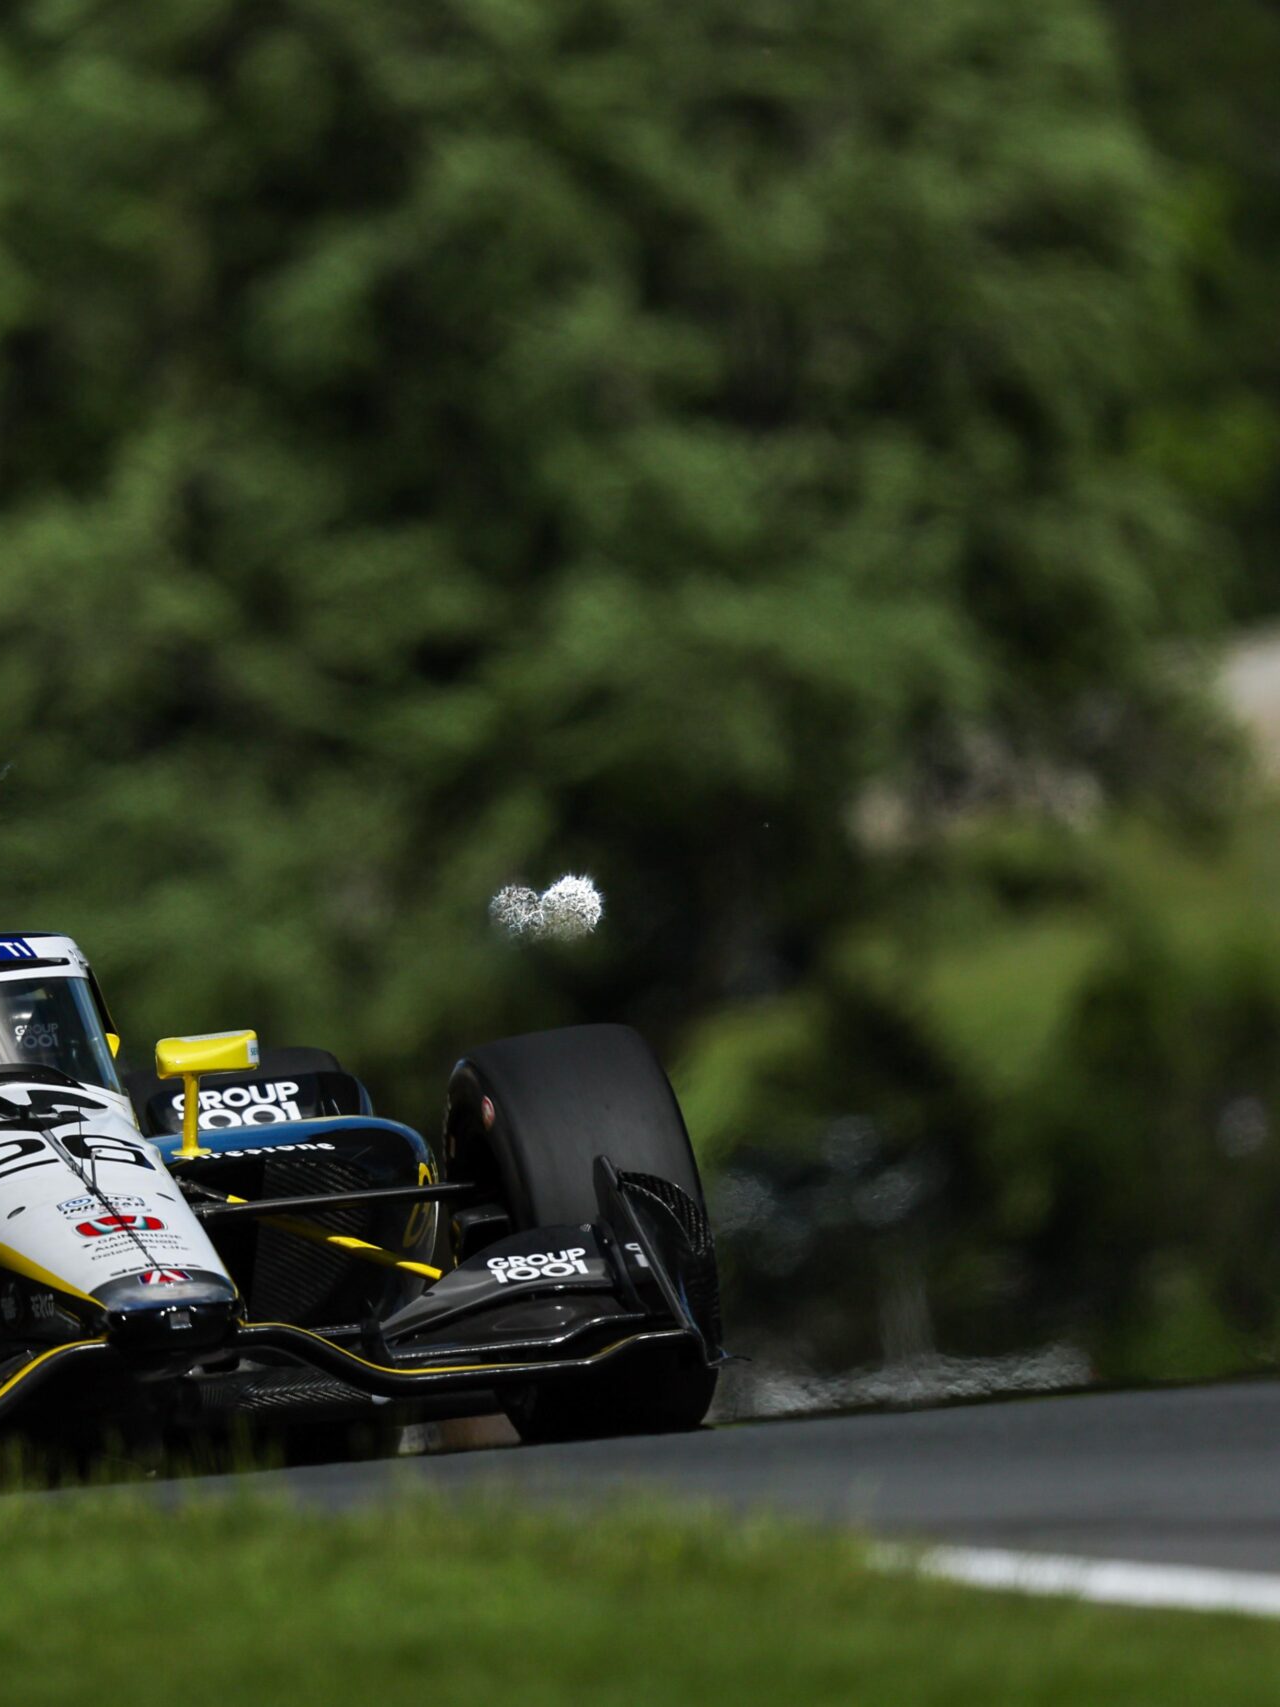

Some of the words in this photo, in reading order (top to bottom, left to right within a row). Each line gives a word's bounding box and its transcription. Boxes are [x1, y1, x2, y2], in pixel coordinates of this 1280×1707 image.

[172, 1081, 300, 1110] GROUP
[178, 1101, 302, 1130] 001
[97, 1231, 183, 1245] GAINRIDGE
[487, 1247, 587, 1271] GROUP
[491, 1259, 589, 1285] 1001
